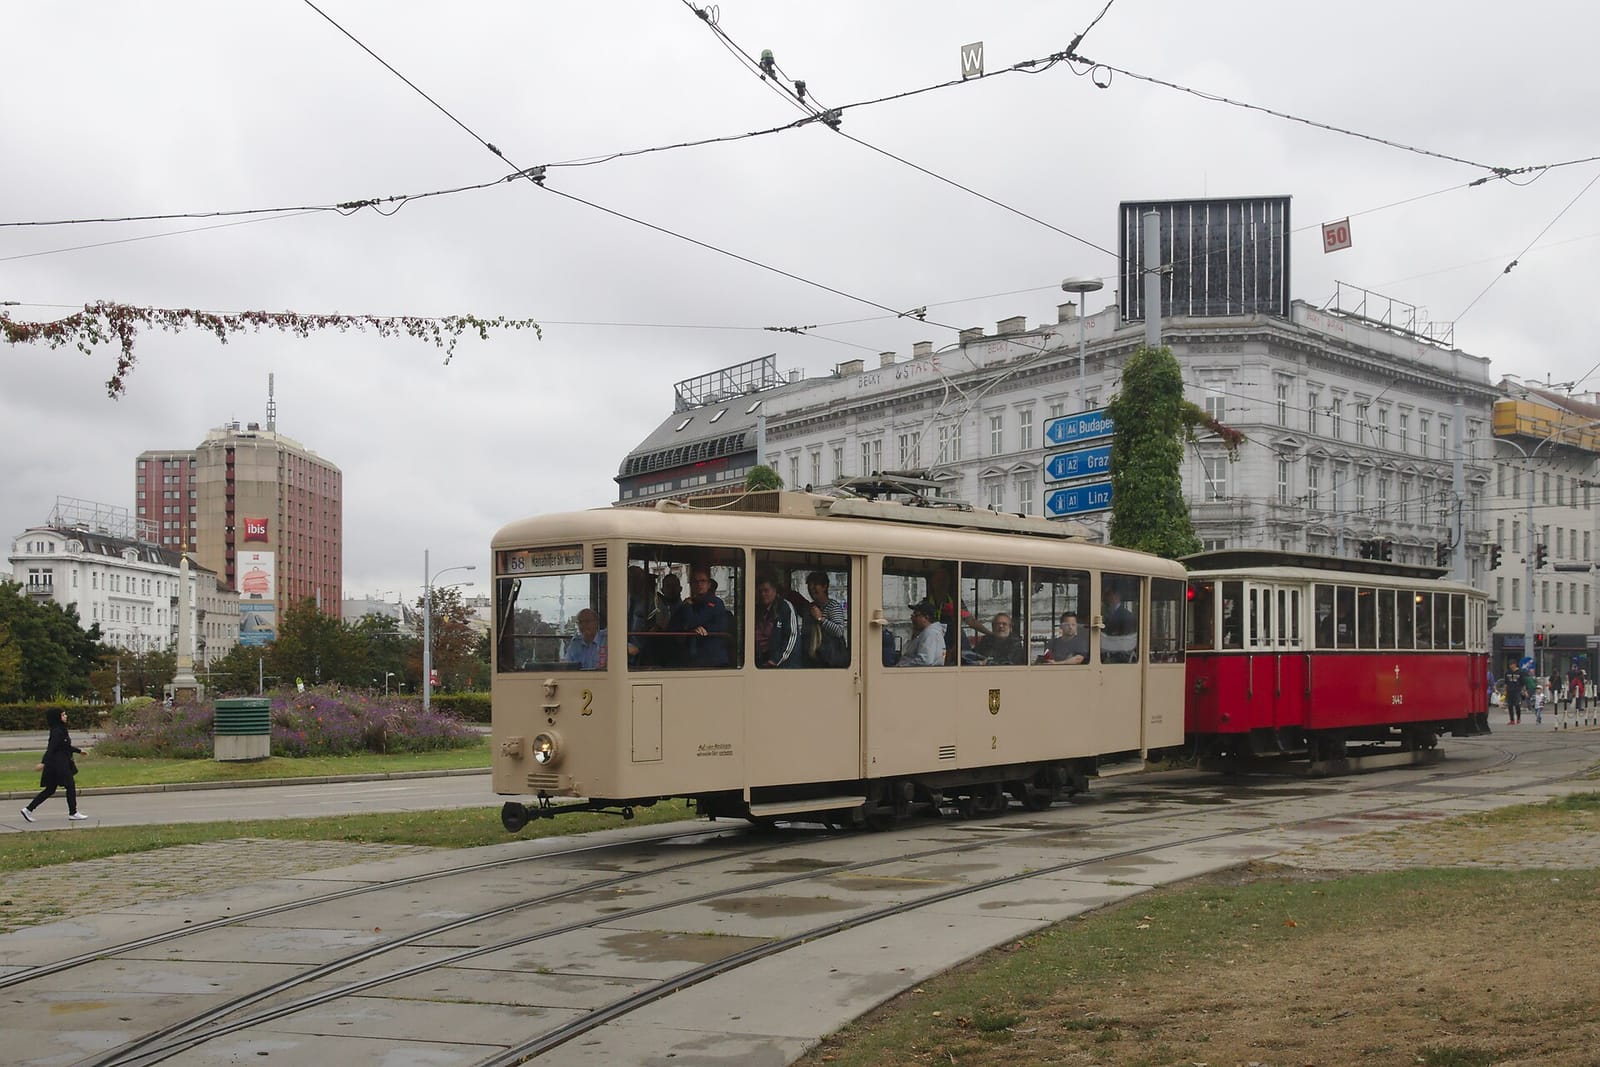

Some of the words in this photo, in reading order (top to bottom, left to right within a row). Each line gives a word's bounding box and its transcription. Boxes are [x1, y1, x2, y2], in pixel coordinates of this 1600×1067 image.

[962, 47, 982, 72] W
[1326, 226, 1347, 246] 50
[858, 373, 881, 388] BECKY
[1067, 423, 1076, 434] A4
[1068, 459, 1077, 470] A2
[1087, 455, 1109, 469] Graz
[1069, 495, 1077, 506] A1
[1088, 491, 1109, 505] Linz
[247, 523, 265, 534] ibis
[511, 556, 525, 570] 58
[580, 689, 593, 716] 2
[991, 735, 998, 750] 2
